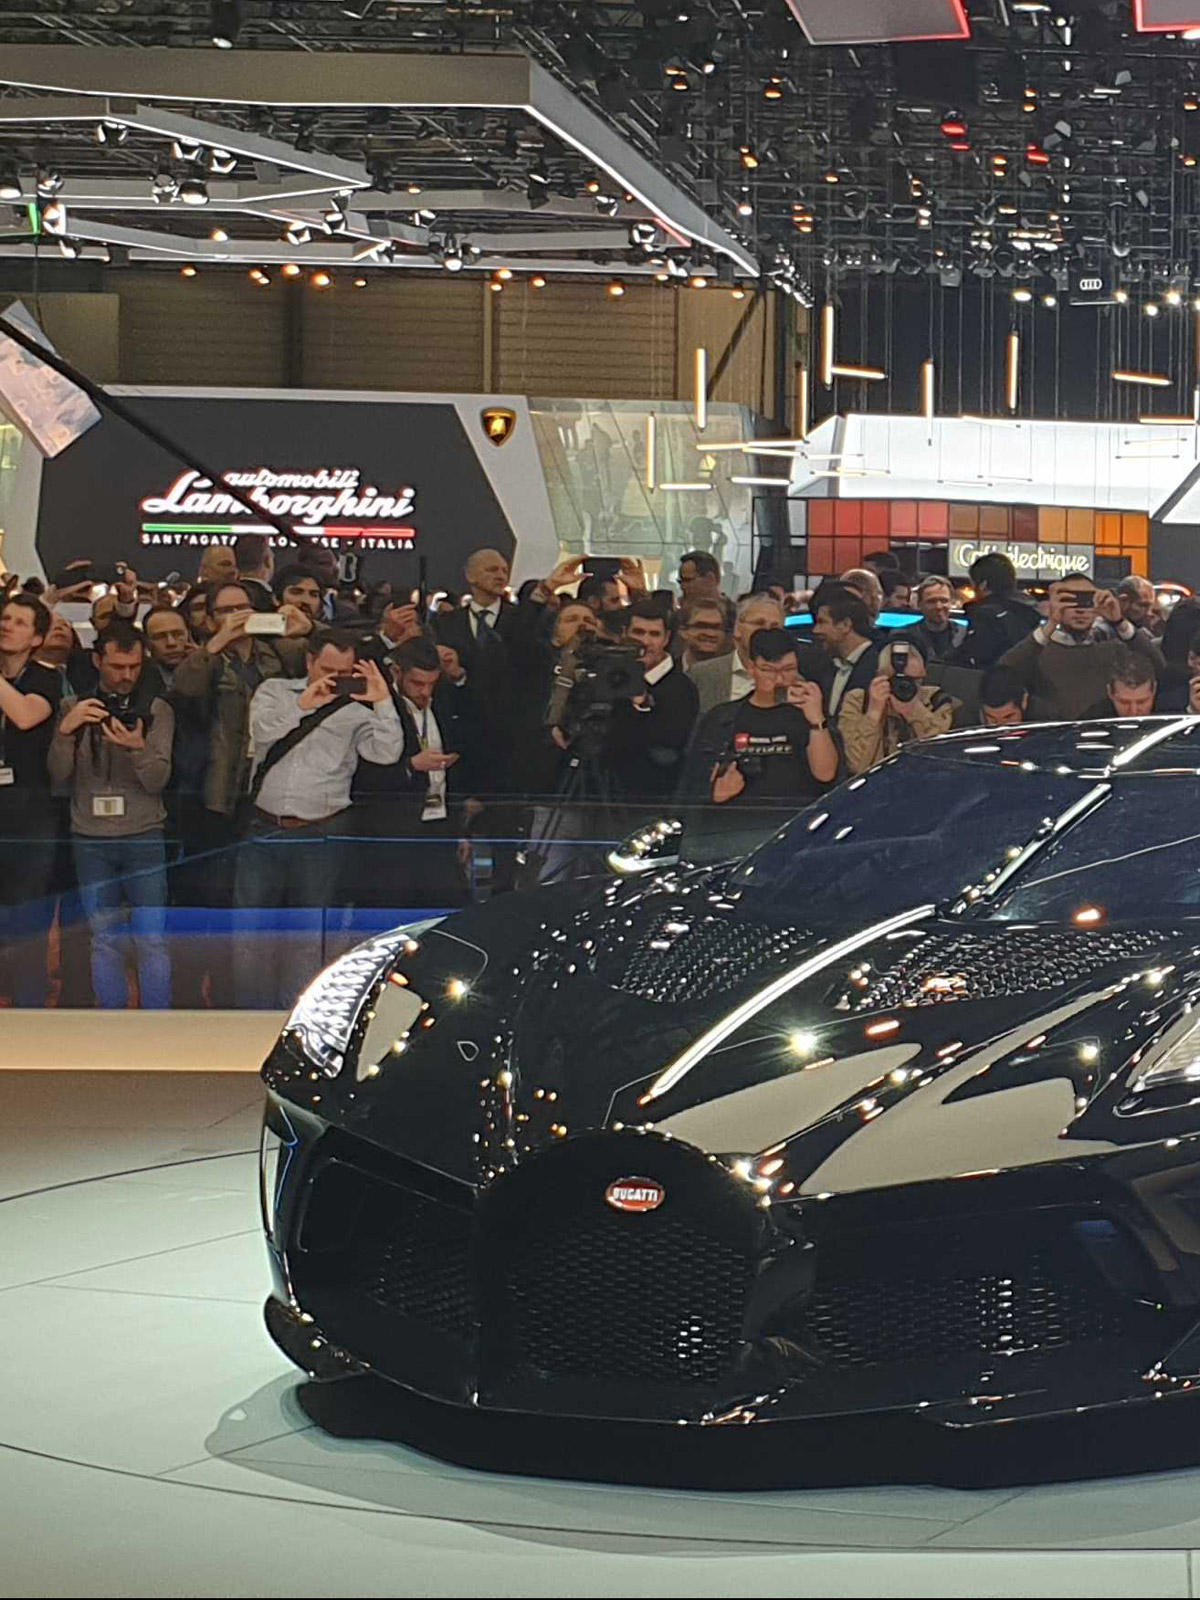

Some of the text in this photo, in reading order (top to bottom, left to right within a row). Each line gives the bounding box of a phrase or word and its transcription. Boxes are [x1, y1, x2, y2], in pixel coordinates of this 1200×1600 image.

[223, 468, 359, 489] automobili
[142, 470, 415, 525] Lamborghini
[360, 537, 414, 550] ITALIA
[612, 1186, 659, 1202] BUGATTI
